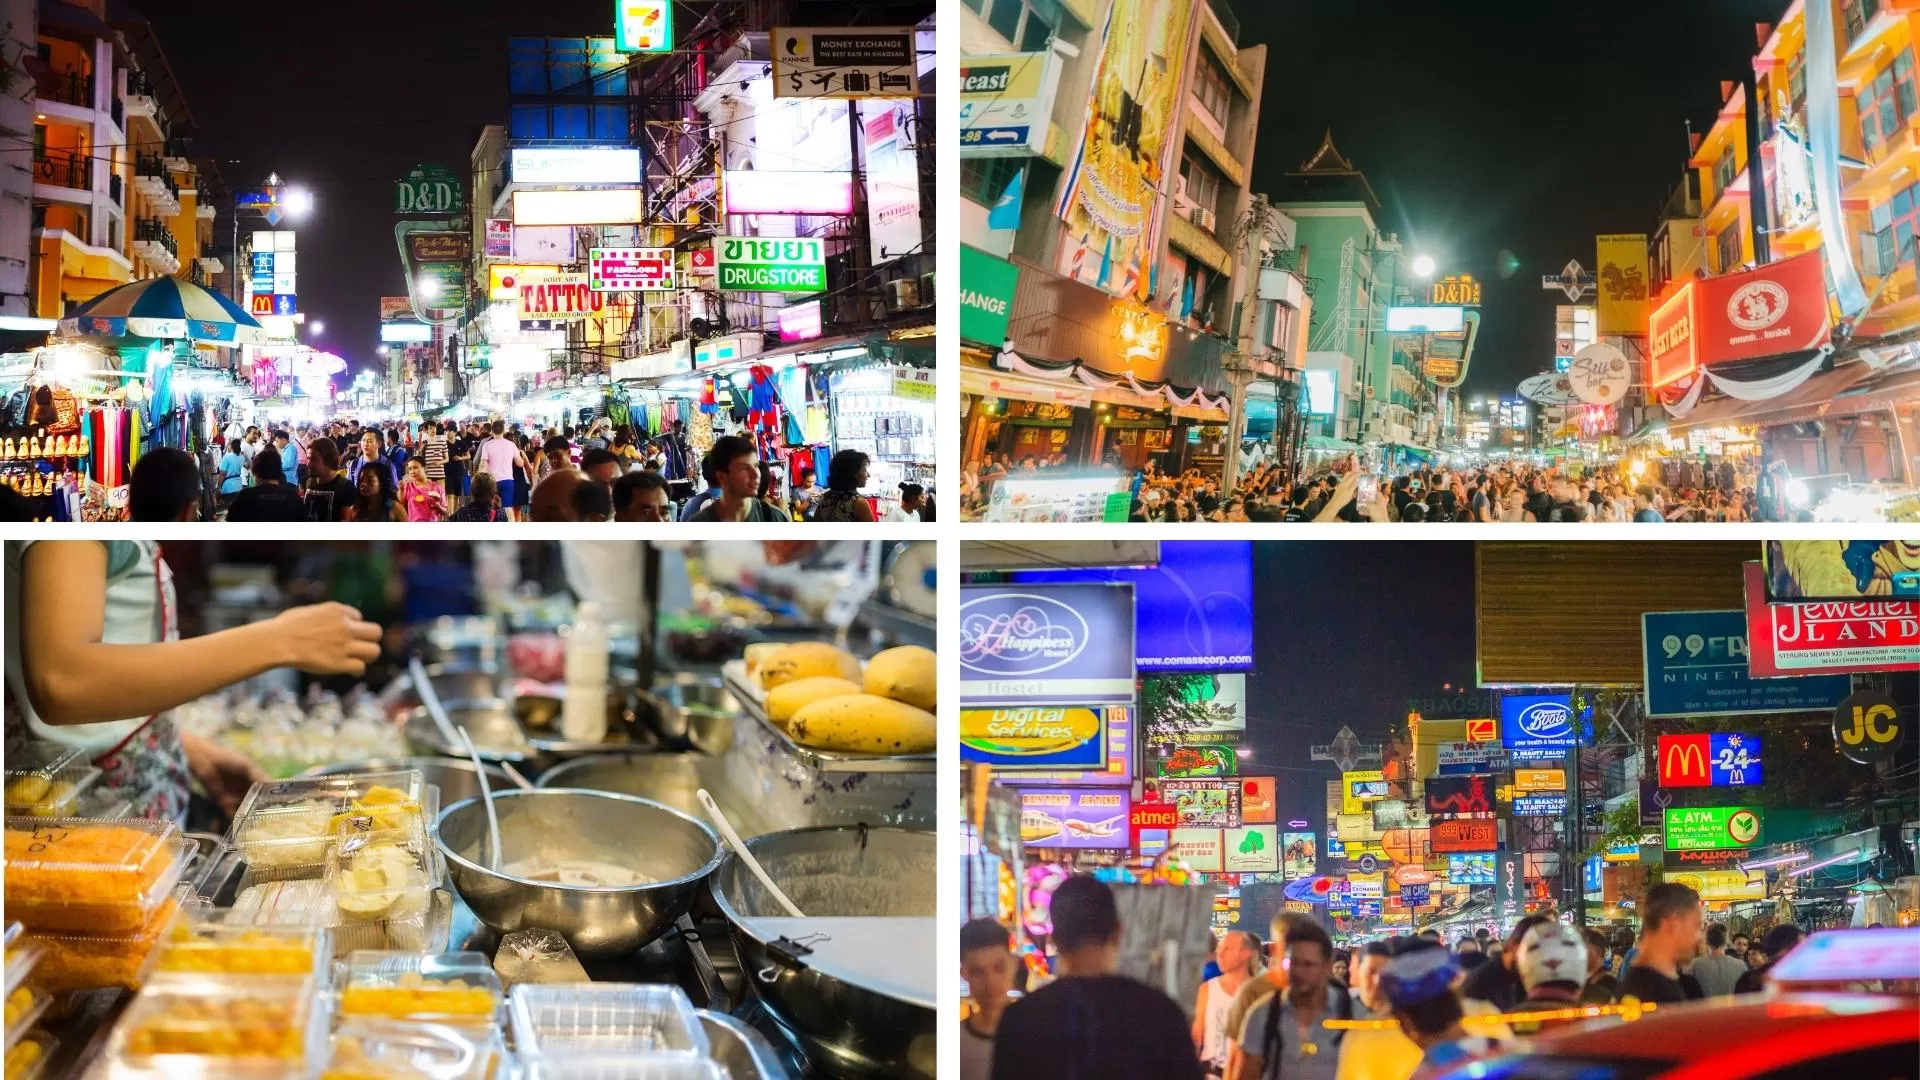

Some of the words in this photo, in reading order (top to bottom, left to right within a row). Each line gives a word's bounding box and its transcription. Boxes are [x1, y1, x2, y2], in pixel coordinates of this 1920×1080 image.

[820, 40, 852, 48] MONEY
[855, 40, 902, 48] EXCHANGE
[398, 183, 452, 211] D&D
[724, 240, 818, 261] ขายยา
[724, 268, 819, 285] DRUGSTORE
[1433, 283, 1472, 304] D&D
[1805, 619, 1919, 642] LAND
[1136, 655, 1252, 666] www.comasscorp.com
[987, 681, 1043, 695] Hostel
[991, 708, 1066, 726] Digital
[1526, 709, 1567, 731] Boots
[1841, 705, 1899, 745] JC
[986, 723, 1073, 738] Services
[1453, 742, 1485, 751] NAT
[1489, 759, 1510, 768] ATM
[1719, 748, 1748, 770] 24
[1191, 781, 1223, 789] TATTOO
[1684, 812, 1713, 823] ATM
[1441, 824, 1457, 835] 999
[1458, 825, 1489, 841] WEST
[1400, 886, 1412, 897] SIM
